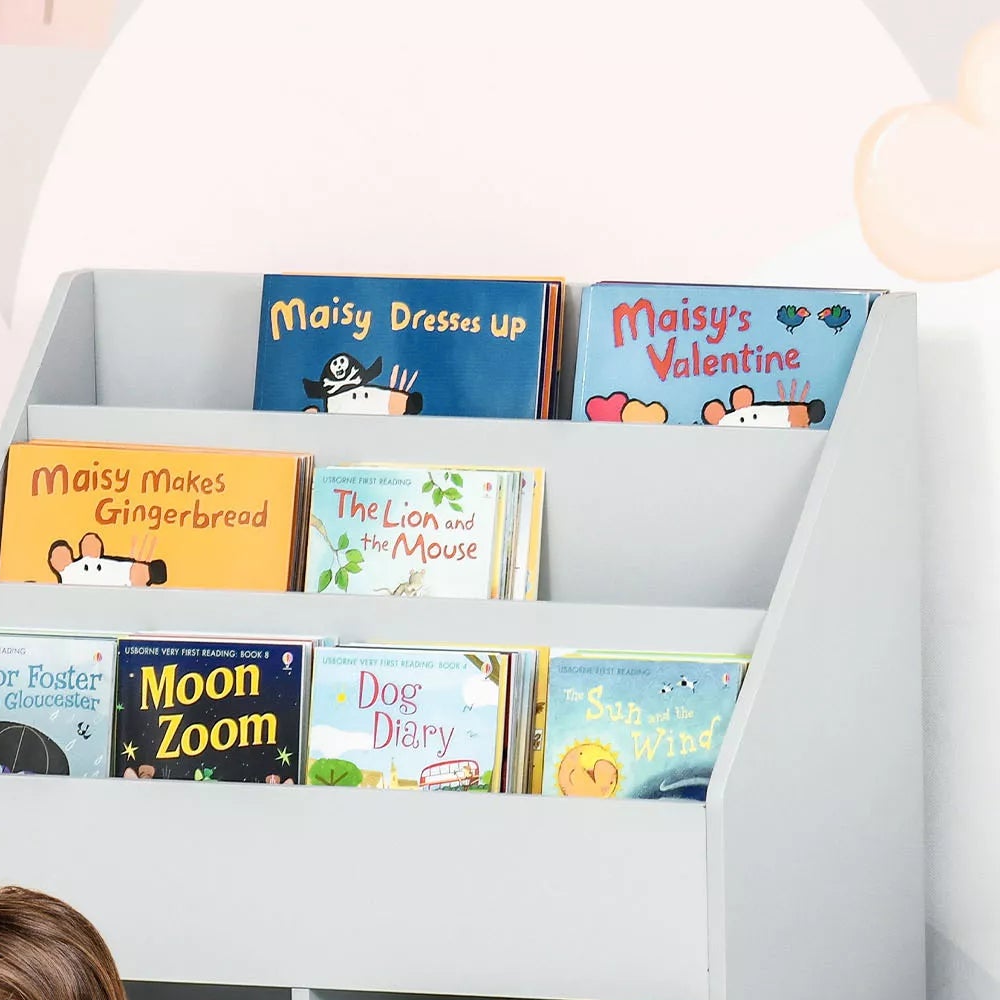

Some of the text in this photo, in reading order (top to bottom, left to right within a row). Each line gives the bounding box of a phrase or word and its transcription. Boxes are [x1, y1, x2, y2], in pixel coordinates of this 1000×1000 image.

[270, 296, 372, 341] Maisy
[391, 301, 481, 333] Dresses
[612, 298, 751, 348] Maisy's
[646, 337, 800, 382] Valentine
[31, 461, 130, 497] Maisy
[358, 477, 377, 485] FIRST
[379, 478, 412, 486] READING
[94, 497, 268, 530] Gingerbread
[333, 488, 475, 531] The Lion and
[360, 532, 478, 563] the Mouse
[124, 647, 159, 656] USBORNE
[161, 648, 180, 656] VERY
[181, 648, 200, 657] FIRST
[240, 650, 263, 659] BOOK
[264, 651, 270, 659] 8
[27, 664, 103, 690] Foster
[140, 663, 261, 711] Moon
[358, 670, 422, 715] Dog
[4, 690, 100, 711] Gloucester
[563, 685, 694, 726] The Sun and the
[155, 712, 278, 760] Zoom
[373, 711, 455, 758] Diary
[630, 714, 723, 761] Wind
